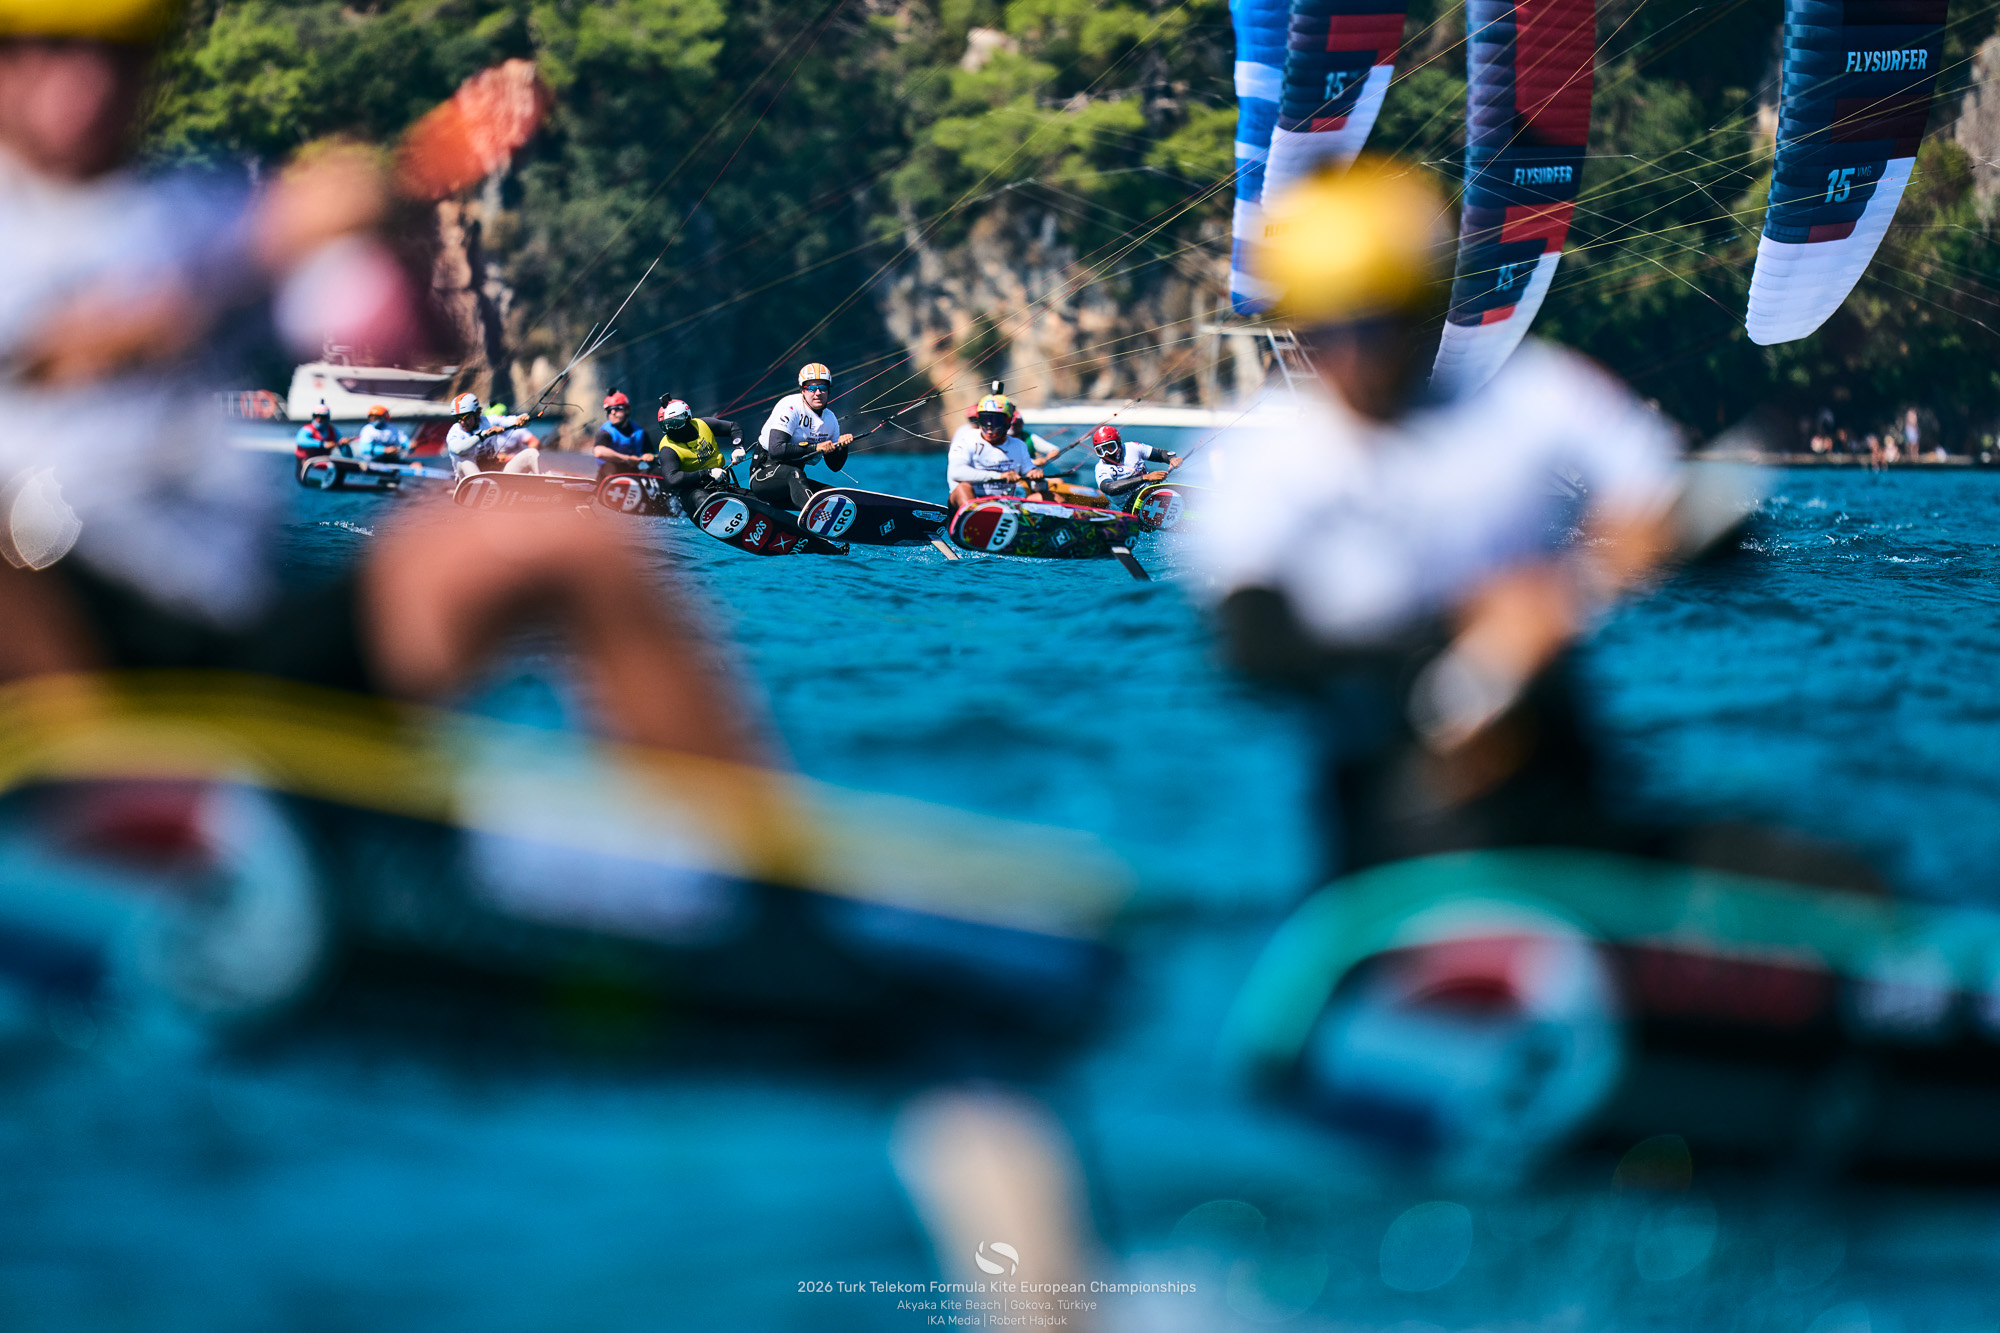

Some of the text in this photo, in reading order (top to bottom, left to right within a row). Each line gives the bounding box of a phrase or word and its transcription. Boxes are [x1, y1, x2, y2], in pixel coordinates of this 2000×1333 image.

[1845, 49, 1928, 73] FLYSURFER
[1324, 71, 1348, 101] 15
[1514, 165, 1574, 186] FLYSURFER
[1824, 165, 1872, 204] 15 VMG
[1495, 262, 1518, 293] 15
[626, 489, 638, 506] SUI
[724, 512, 745, 534] SGP
[833, 508, 852, 533] CRO
[1166, 502, 1180, 521] SUI
[745, 520, 768, 546] Yeo's
[992, 518, 1013, 546] CHN
